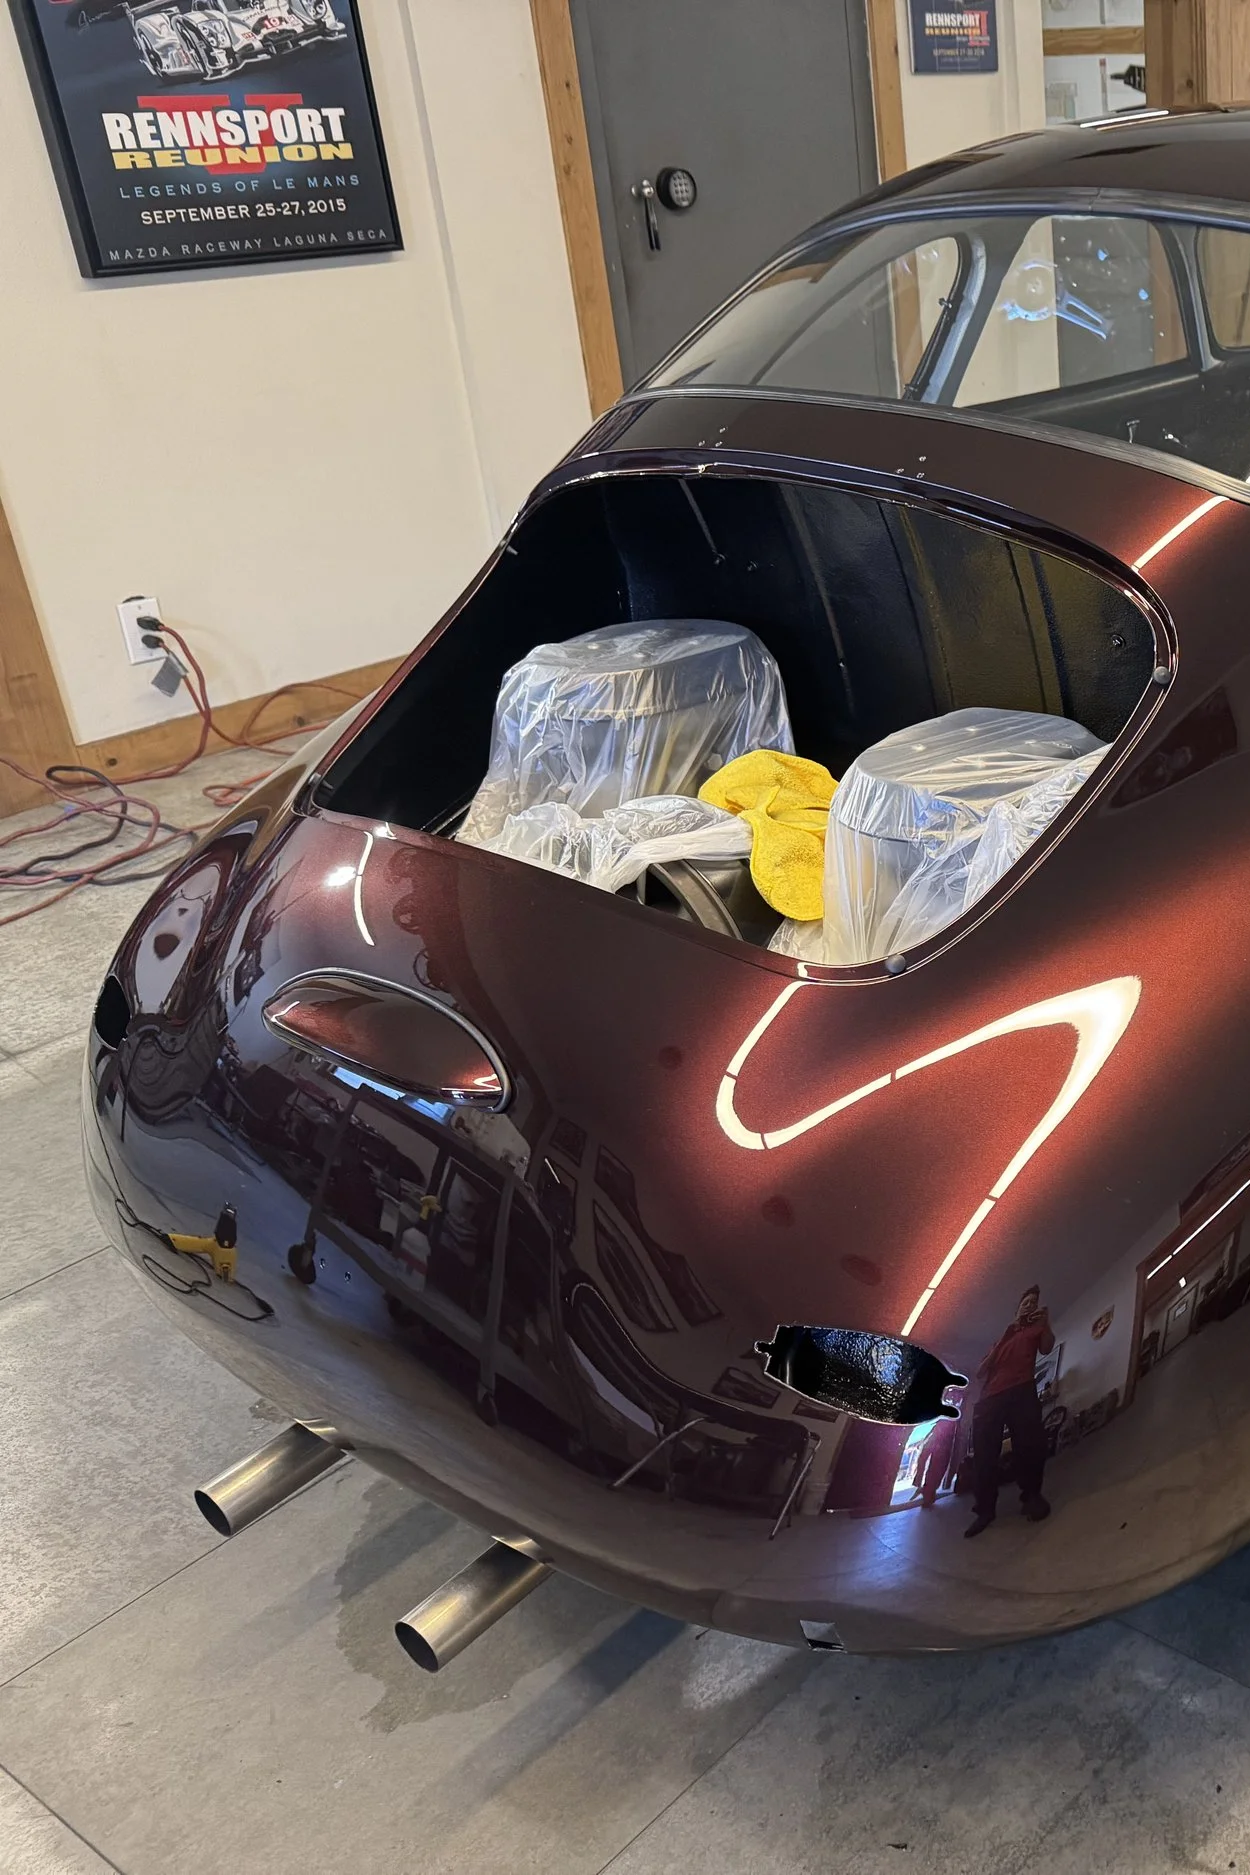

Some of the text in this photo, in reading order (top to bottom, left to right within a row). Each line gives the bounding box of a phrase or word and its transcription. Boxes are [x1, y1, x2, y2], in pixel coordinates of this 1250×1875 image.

[925, 12, 980, 27] RENNSPORT
[101, 107, 345, 150] RENNSPORT
[112, 143, 354, 170] REUNION
[120, 175, 359, 199] LEGENDS OF LE MANS
[141, 198, 347, 225] SEPTEMBER 25-27, 2015
[109, 229, 387, 261] MAZDA RACEWAY LAGUNA SECA
